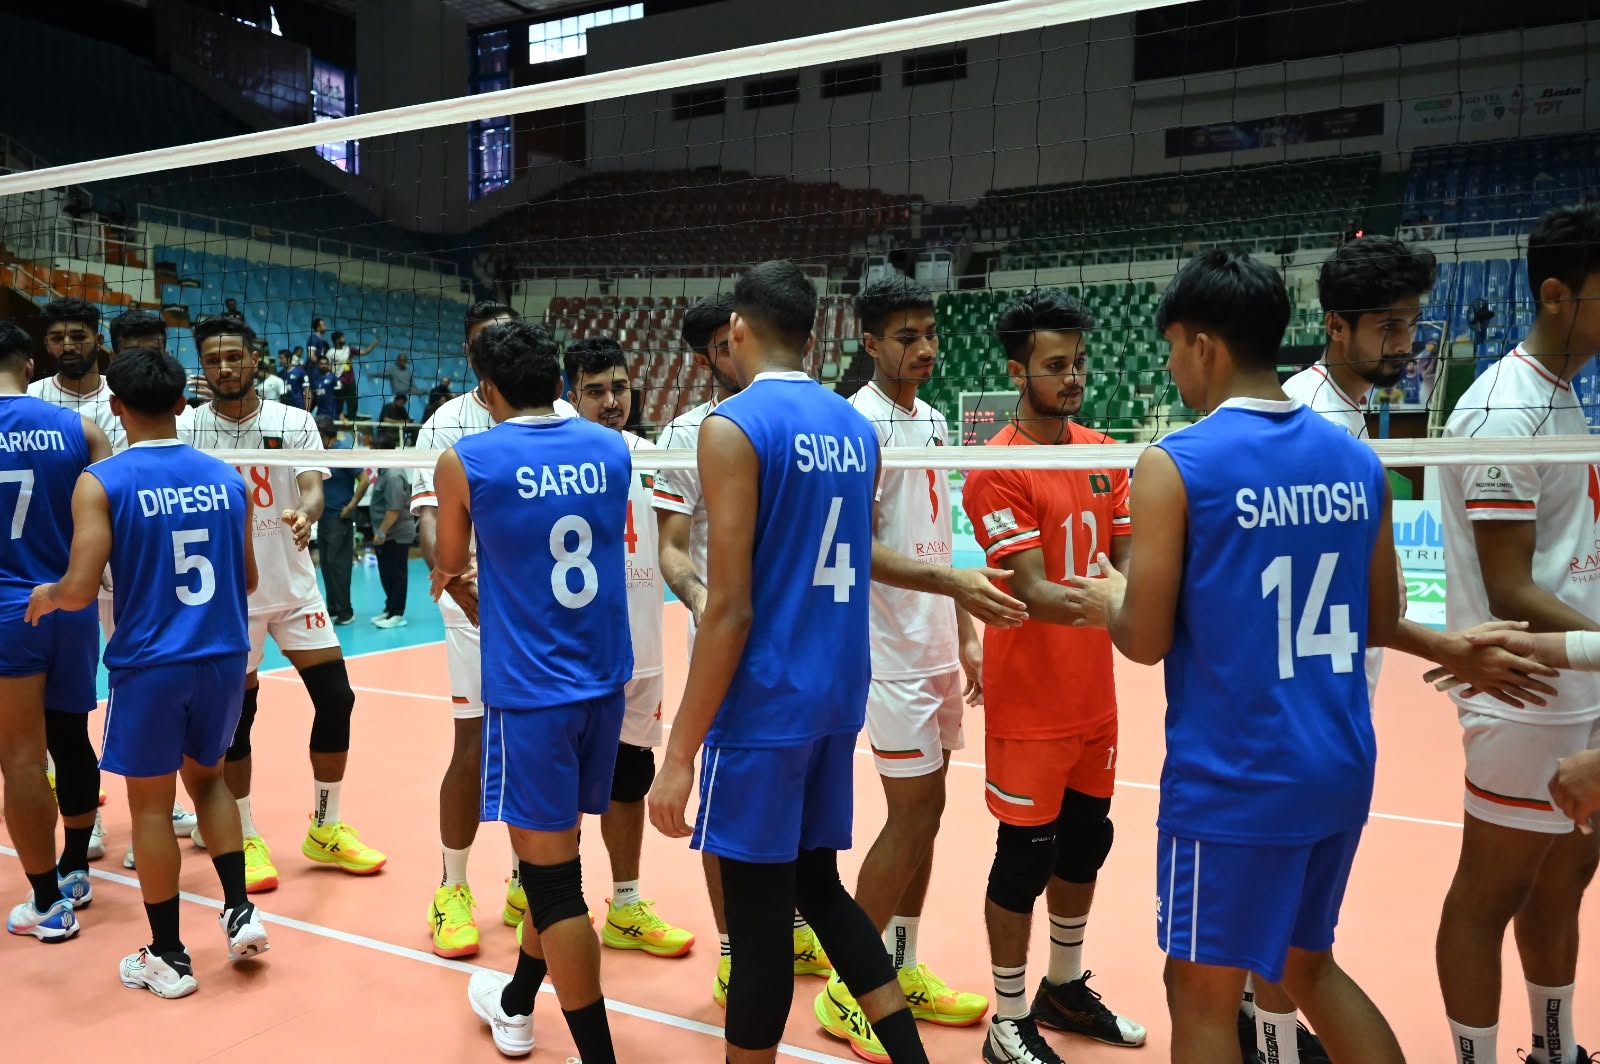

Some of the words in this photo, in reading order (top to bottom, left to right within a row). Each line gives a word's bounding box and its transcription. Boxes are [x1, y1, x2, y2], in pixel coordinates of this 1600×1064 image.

[0, 429, 65, 453] ARKOTI
[794, 433, 866, 473] SURAJ
[516, 462, 606, 499] SAROJ
[138, 484, 230, 518] DIPESH
[1236, 481, 1369, 529] SANTOSH
[623, 500, 638, 554] 4
[1061, 510, 1102, 581] 12
[172, 528, 216, 606] 5
[549, 514, 599, 609] 8
[813, 496, 856, 603] 4
[1403, 549, 1444, 560] TRI
[305, 611, 326, 629] 18
[1261, 552, 1359, 680] 14
[653, 700, 662, 720] 4
[1104, 745, 1116, 769] 1
